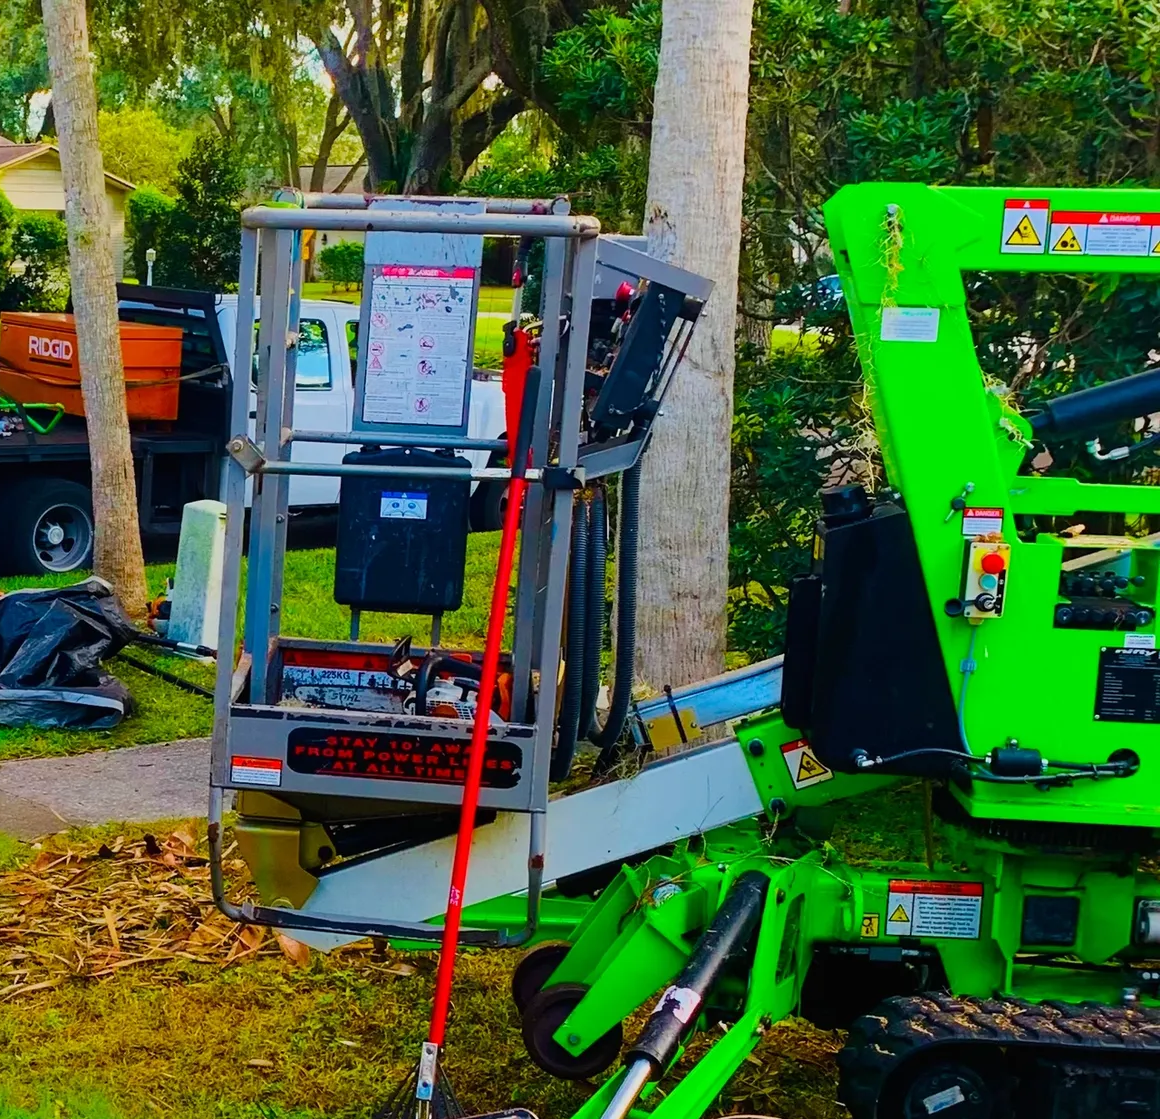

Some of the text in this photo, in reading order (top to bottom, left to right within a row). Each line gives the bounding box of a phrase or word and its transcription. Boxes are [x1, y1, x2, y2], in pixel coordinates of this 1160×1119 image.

[1109, 215, 1141, 223] DANGER
[28, 335, 73, 360] RIDGID
[321, 670, 351, 680] 225KG
[330, 692, 360, 702] STIHL
[326, 736, 378, 748] STAY
[431, 743, 488, 755] AWA
[295, 746, 513, 770] FROM POWER LIES
[333, 760, 356, 770] AT
[367, 764, 404, 774] ALL
